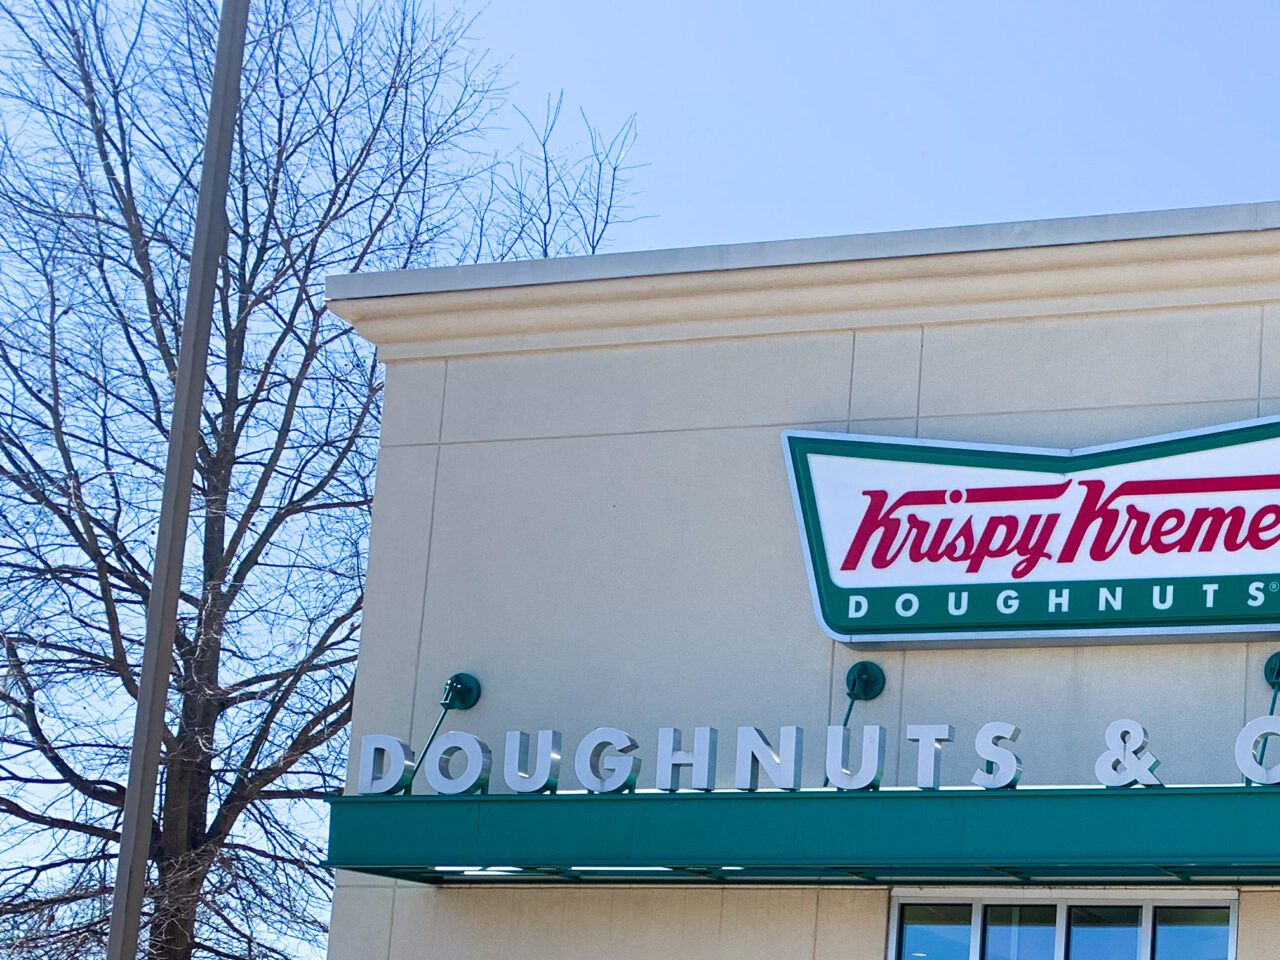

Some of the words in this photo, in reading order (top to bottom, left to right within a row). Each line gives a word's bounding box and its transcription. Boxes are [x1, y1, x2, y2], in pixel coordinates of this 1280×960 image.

[840, 478, 1073, 579] Krispy
[357, 721, 1024, 795] DOUGHNUTS
[1094, 717, 1166, 788] &
